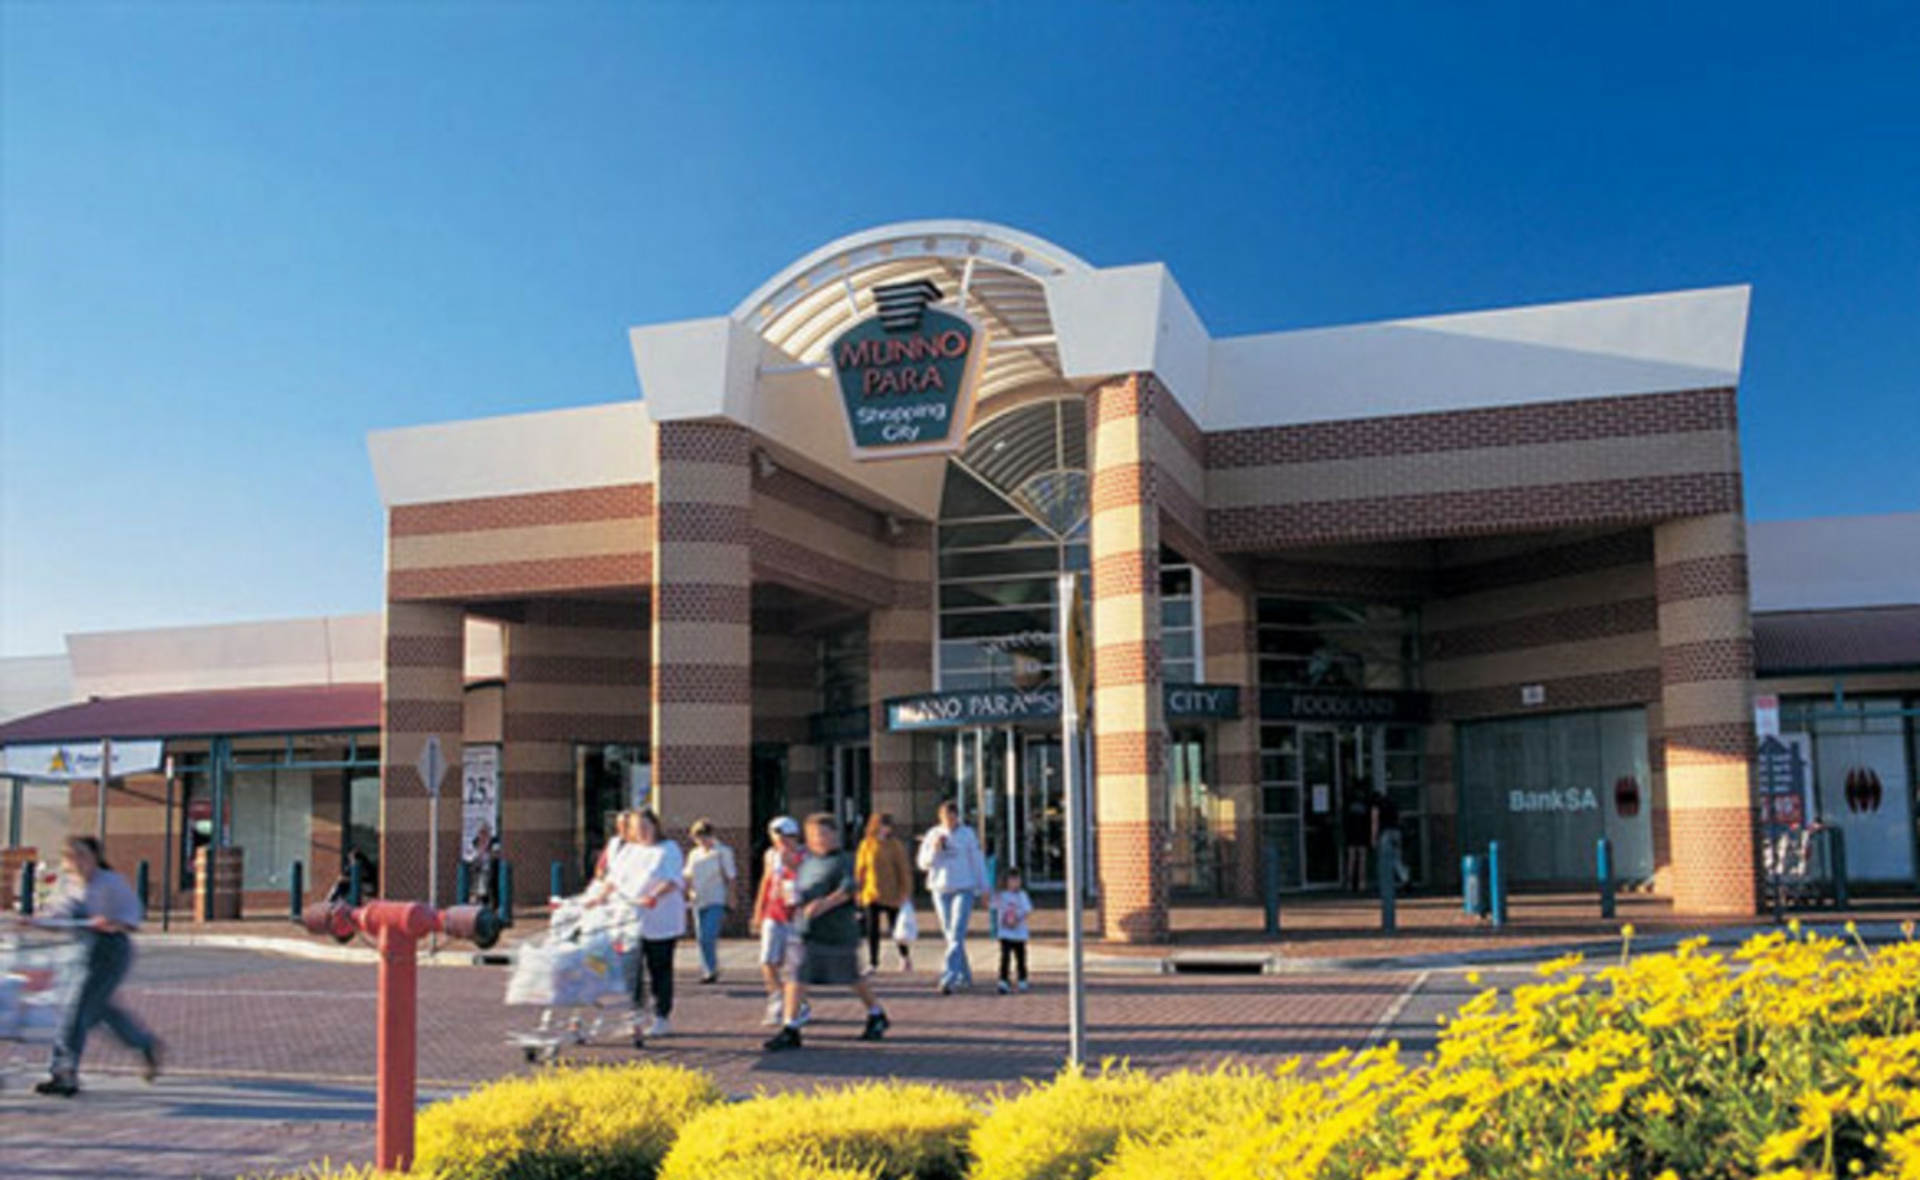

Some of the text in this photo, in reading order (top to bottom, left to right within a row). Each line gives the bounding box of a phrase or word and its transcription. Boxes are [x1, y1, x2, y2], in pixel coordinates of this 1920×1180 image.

[839, 330, 967, 369] MUNNO
[863, 366, 944, 396] PARA
[857, 403, 946, 425] Shopping
[882, 424, 920, 441] City
[969, 694, 1028, 716] PARA
[1169, 690, 1218, 713] CITY
[1509, 787, 1599, 812] BankSA
